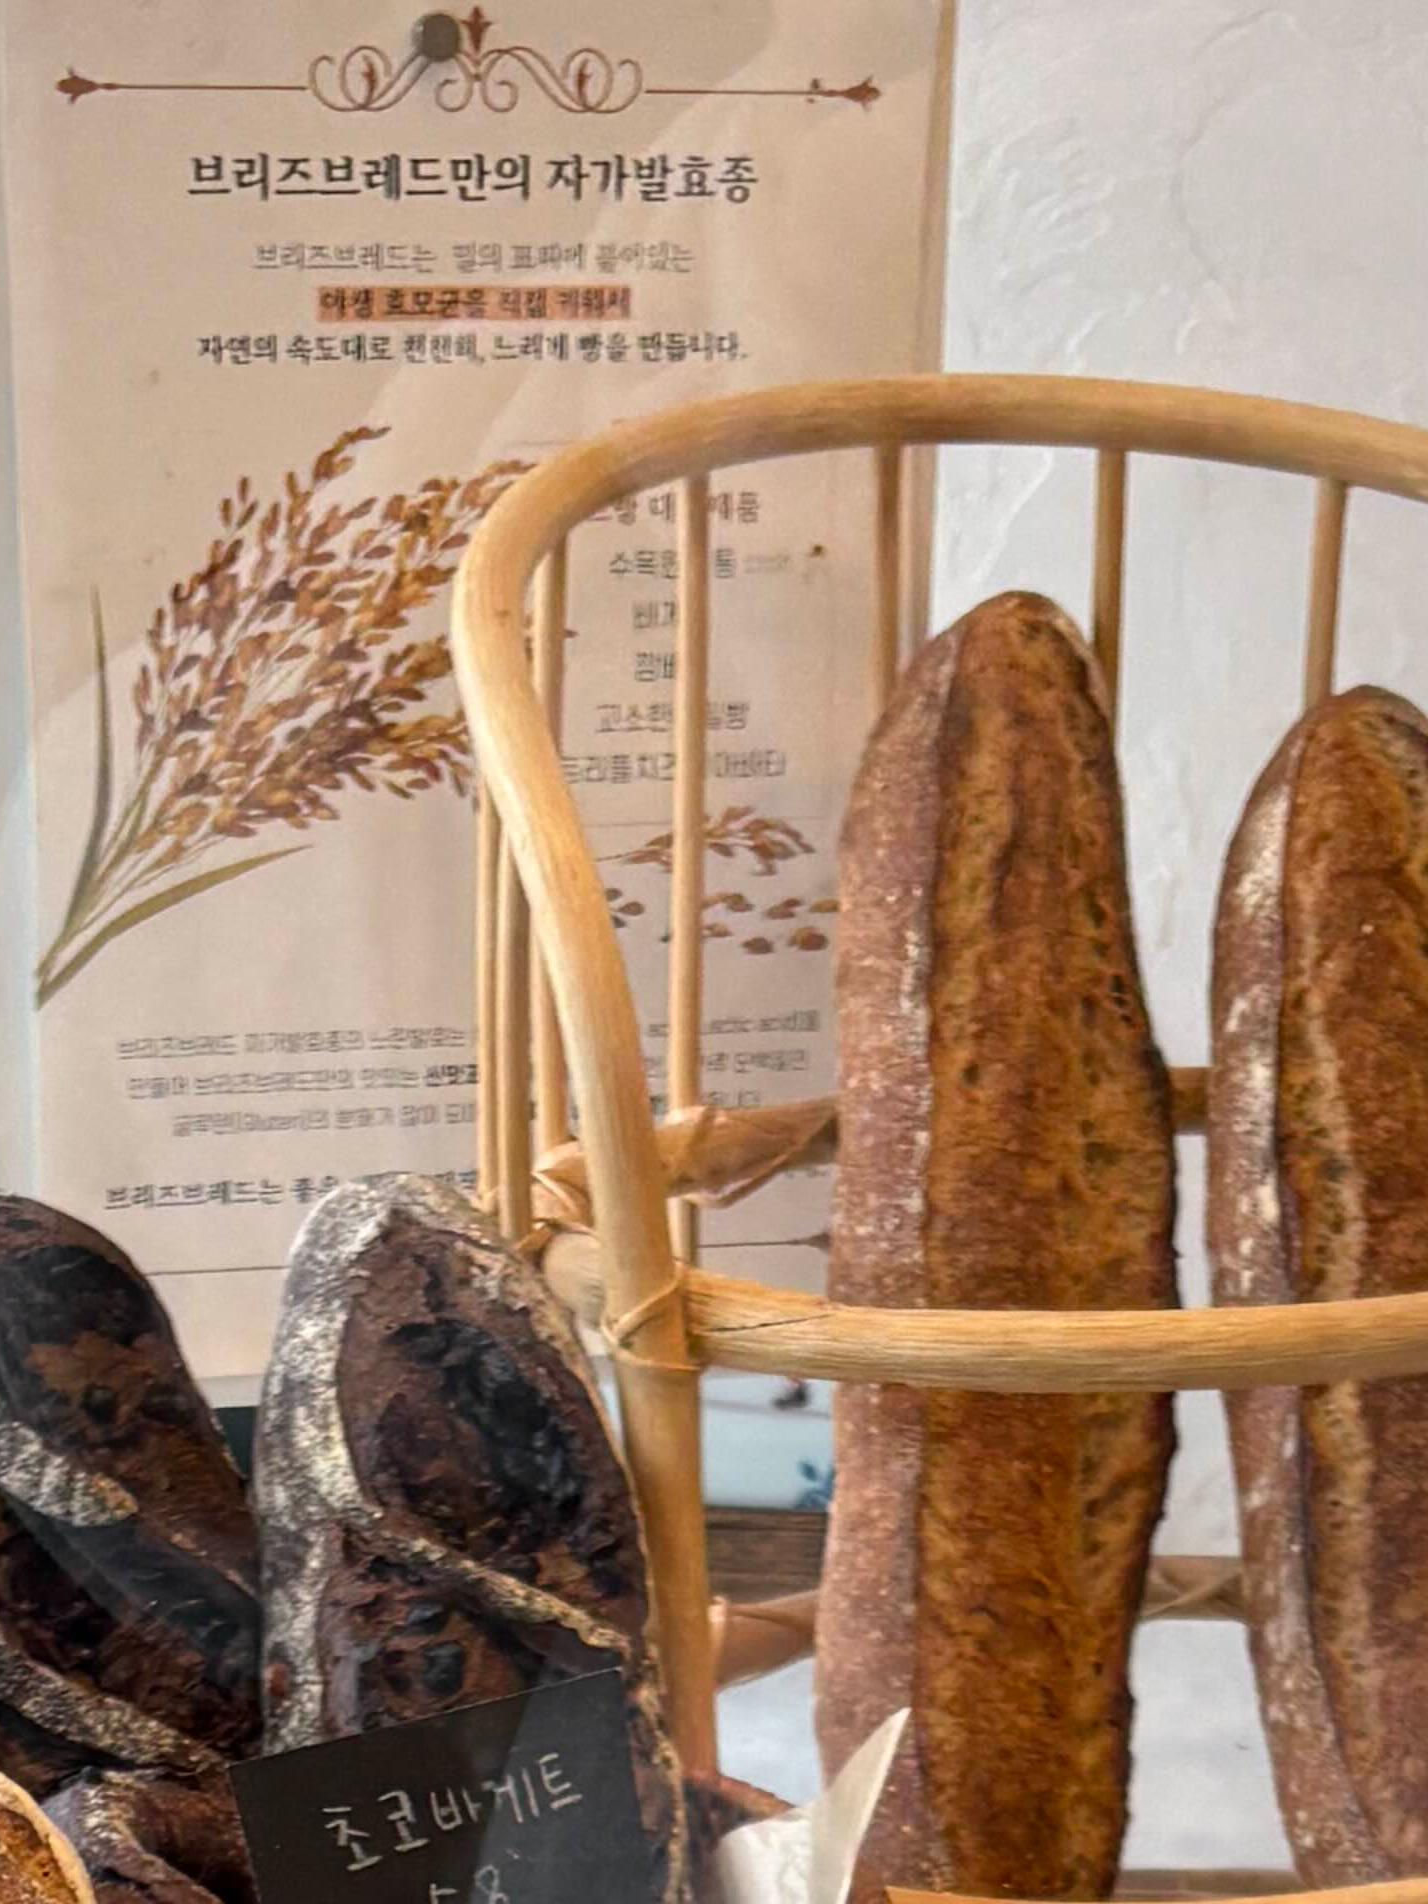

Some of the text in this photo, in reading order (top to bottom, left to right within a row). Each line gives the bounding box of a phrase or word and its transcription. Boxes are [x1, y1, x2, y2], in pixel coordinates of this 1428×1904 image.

[188, 152, 759, 204] 브리즈브레드만의 자가발효종
[253, 242, 438, 273] 브리즈브레드는
[385, 288, 488, 320] 효모균을
[197, 334, 277, 364] 자연의
[286, 334, 393, 365] 속도대로
[492, 331, 569, 362] 느리게
[577, 331, 632, 363] 빵을
[637, 331, 749, 363] 만듭니다.
[104, 1178, 282, 1210] 브리즈브레드는
[322, 1751, 583, 1873] 초코바게트
